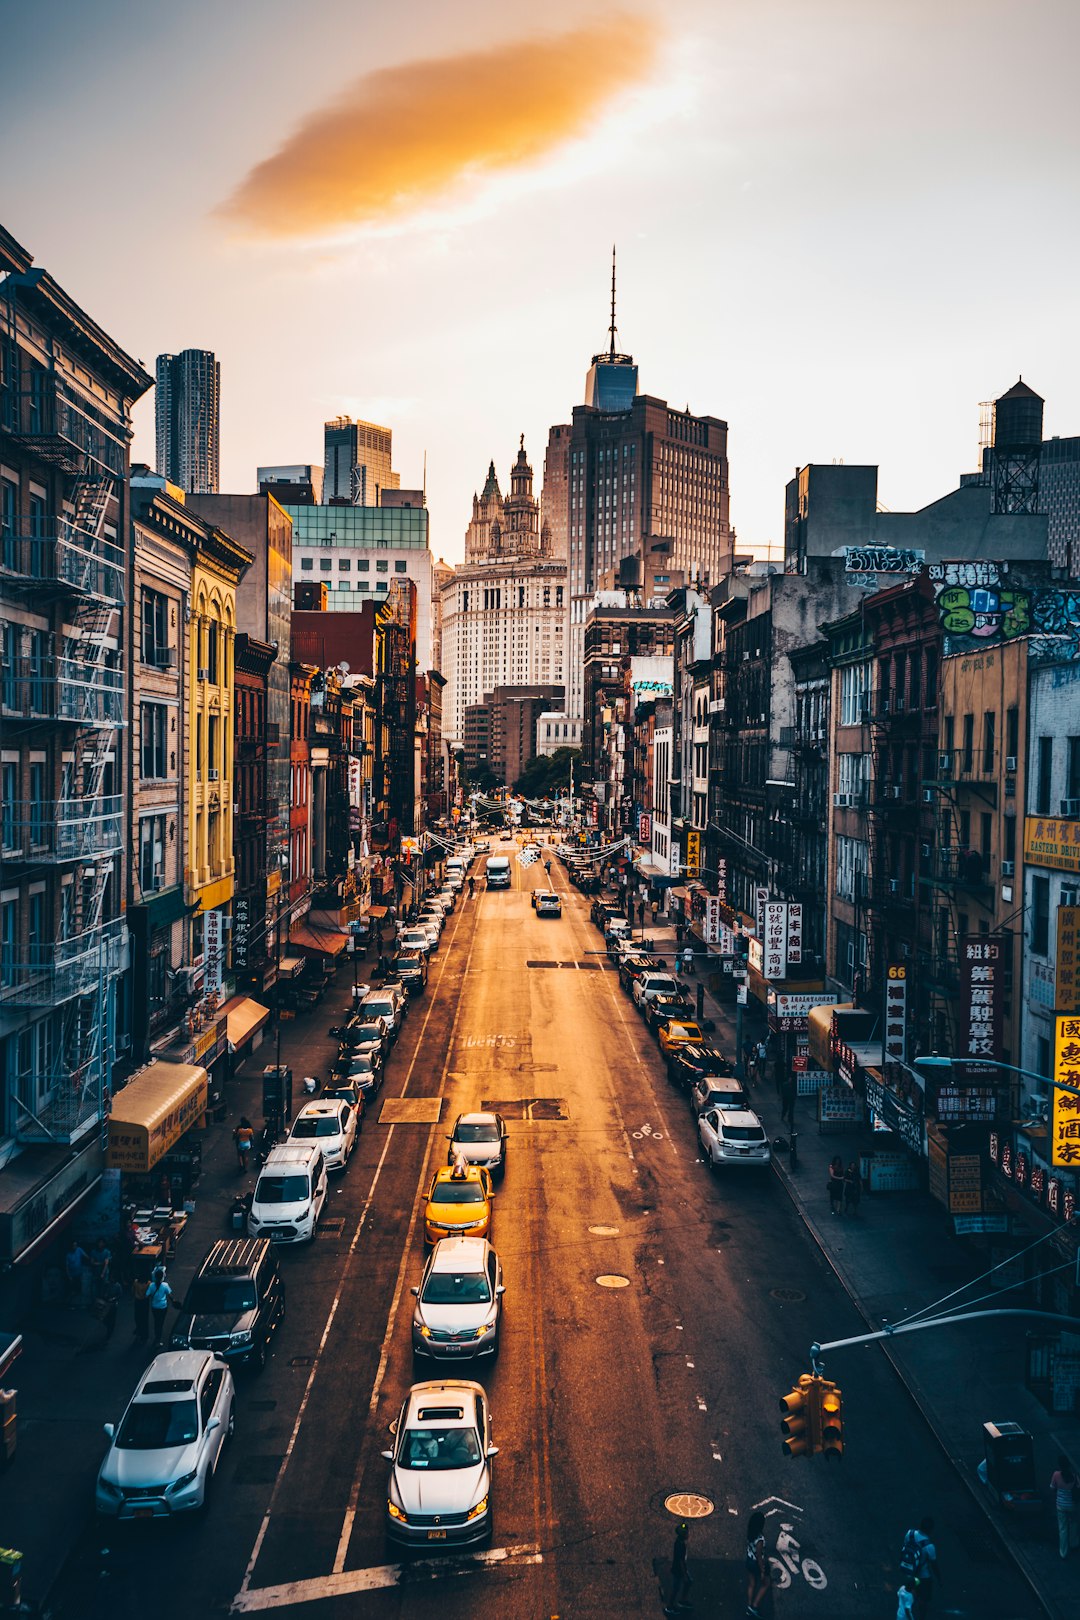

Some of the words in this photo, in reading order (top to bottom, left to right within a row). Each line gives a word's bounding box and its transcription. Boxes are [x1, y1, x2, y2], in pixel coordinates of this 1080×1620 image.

[1030, 840, 1058, 854] EASTERN
[966, 945, 999, 959] 紐約
[888, 967, 906, 979] 66
